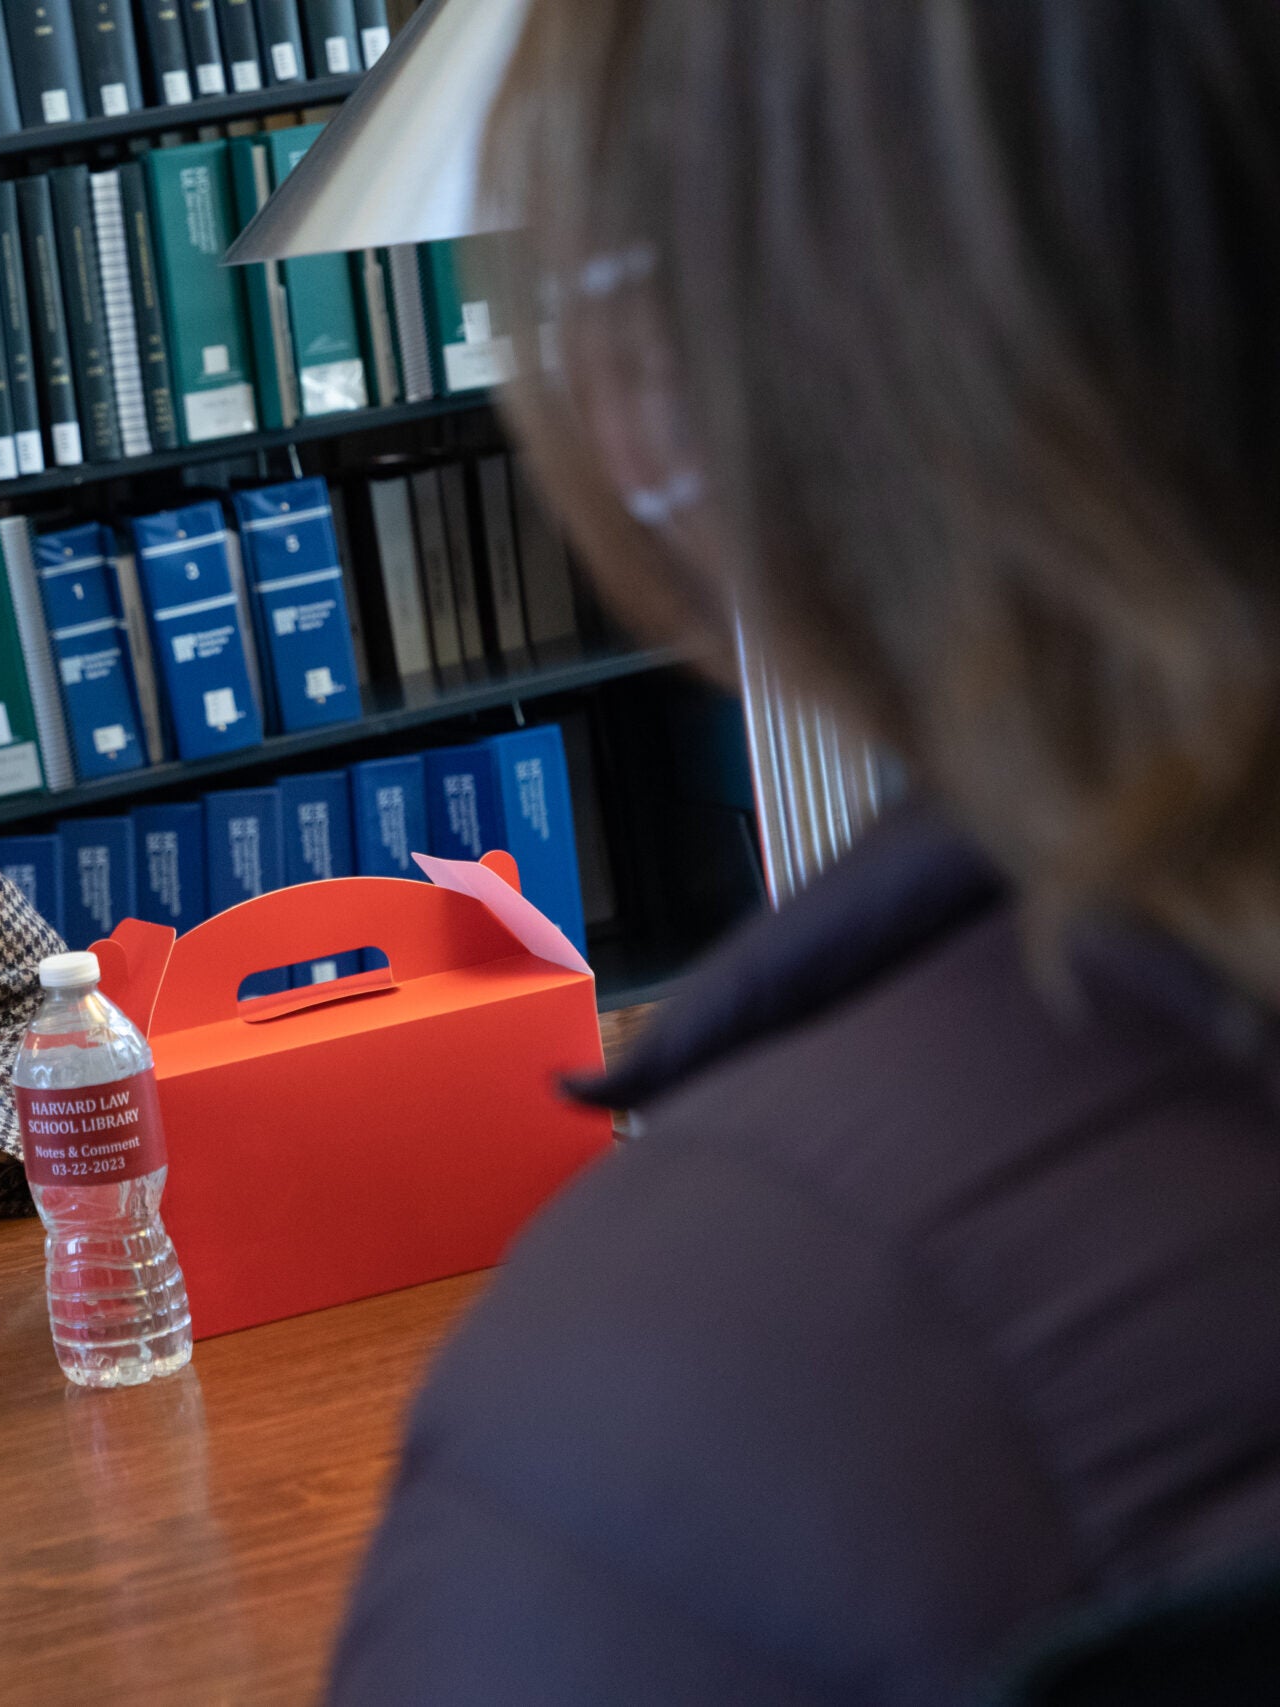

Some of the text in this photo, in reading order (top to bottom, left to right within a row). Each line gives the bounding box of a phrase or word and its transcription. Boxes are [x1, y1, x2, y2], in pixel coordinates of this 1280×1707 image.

[31, 1091, 130, 1116] HARVARD LAW
[28, 1107, 140, 1135] SCHOOL LIBRARY
[35, 1136, 140, 1159] Notes & Comment
[51, 1156, 126, 1176] 03-22-2023
